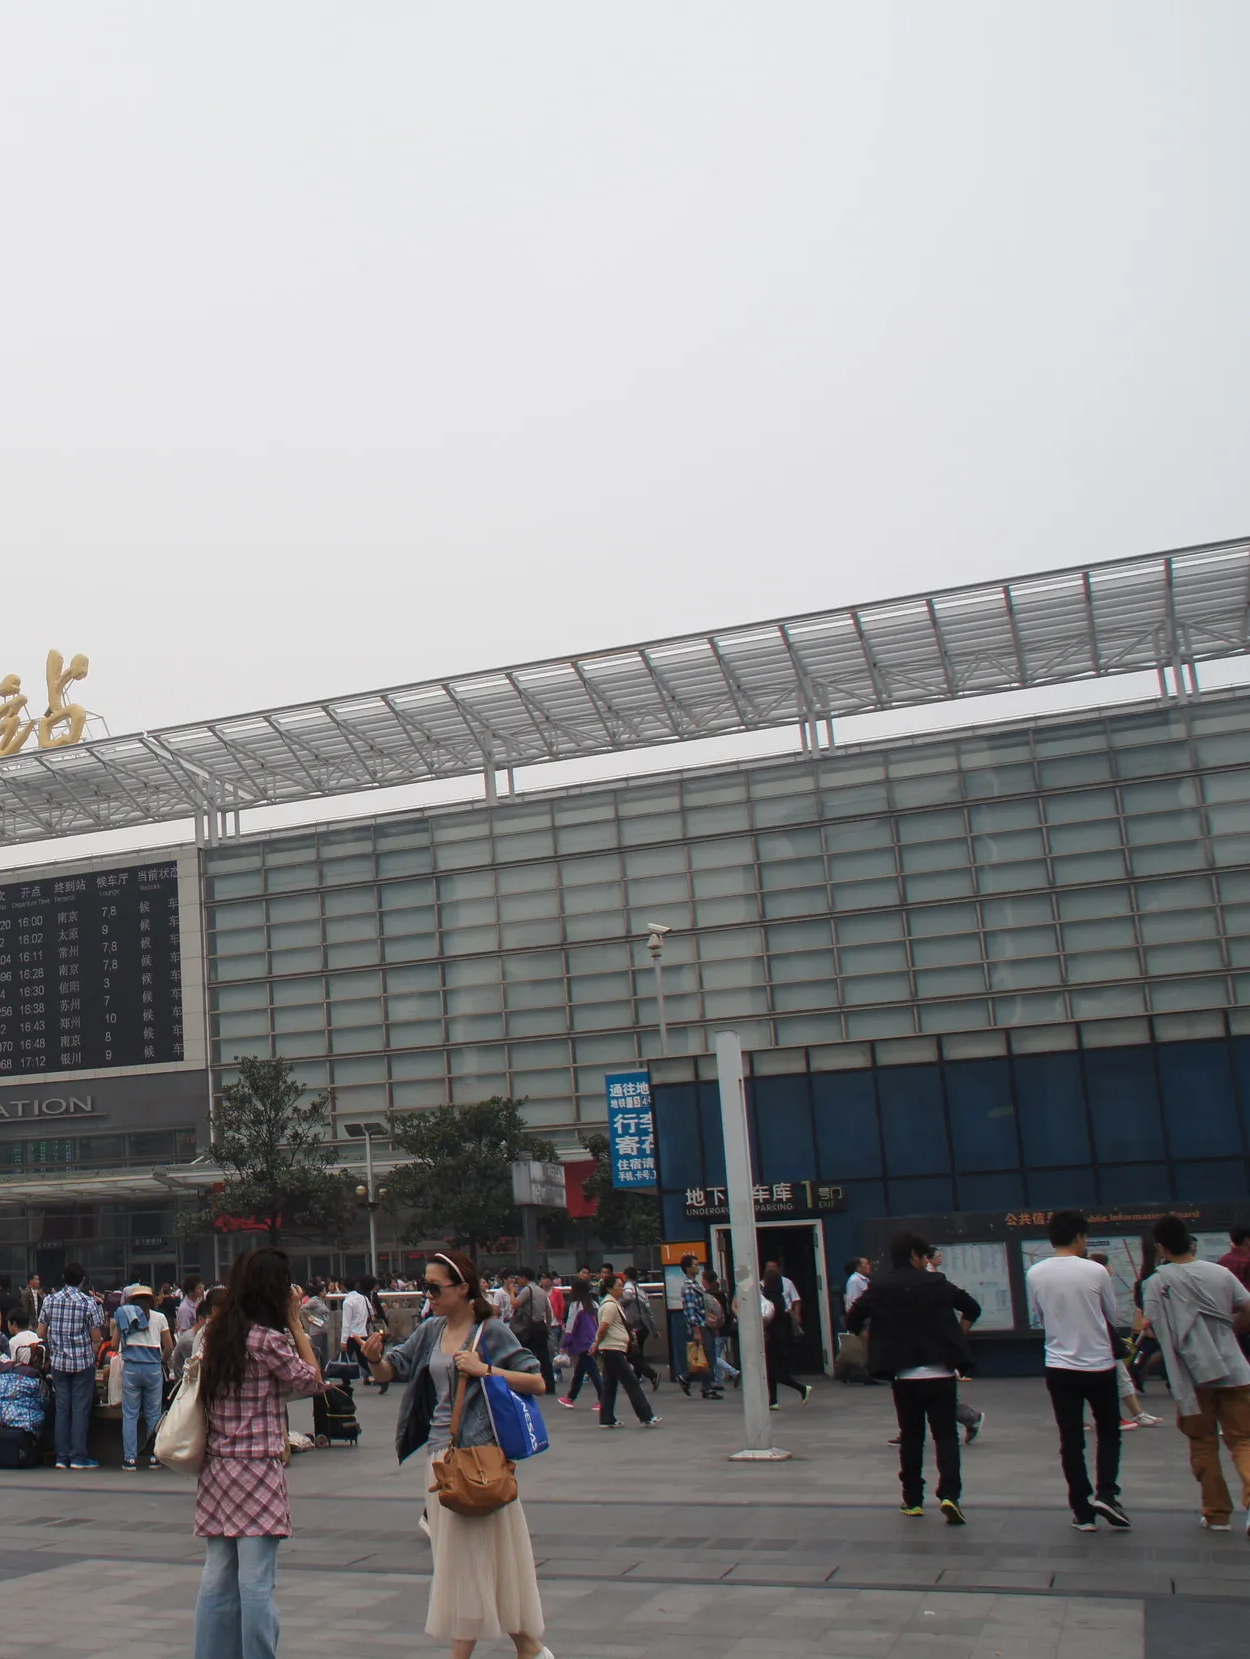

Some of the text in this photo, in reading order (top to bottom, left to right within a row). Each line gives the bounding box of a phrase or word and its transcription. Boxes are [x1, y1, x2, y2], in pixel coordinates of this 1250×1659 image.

[21, 886, 41, 898] 开点
[54, 879, 86, 894] 终到站
[97, 873, 128, 888] 候车厅
[138, 866, 178, 882] 当前状态
[18, 916, 43, 928] 16:00
[57, 911, 78, 924] 南京
[102, 906, 116, 918] 7,8
[18, 933, 43, 945] 16:02
[58, 928, 79, 942] 太原
[102, 925, 108, 935] 9
[19, 951, 43, 962] 16:11
[58, 946, 79, 959] 常州
[103, 941, 117, 954] 7,8
[19, 968, 44, 980] 16:28
[59, 963, 79, 977] 南京
[103, 959, 118, 972] 7,8
[20, 985, 45, 997] 16:30
[59, 981, 80, 994] 信阳
[103, 978, 110, 988] 3
[20, 1003, 45, 1015] 16:38
[60, 999, 80, 1012] 苏州
[104, 996, 110, 1006] 7
[20, 1021, 45, 1033] 16:43
[60, 1017, 81, 1029] 郑州
[105, 1013, 117, 1024] 10
[20, 1039, 45, 1050] 16:48
[60, 1034, 81, 1047] 南京
[105, 1032, 112, 1042] 8
[21, 1056, 46, 1068] 17:12
[60, 1052, 82, 1065] 银川
[106, 1050, 112, 1060] 9
[610, 1082, 650, 1097] 通往地
[618, 1170, 656, 1182] 手机、卡号、
[685, 1180, 842, 1208] 地下车库 1 号门
[755, 1203, 793, 1213] PARKING
